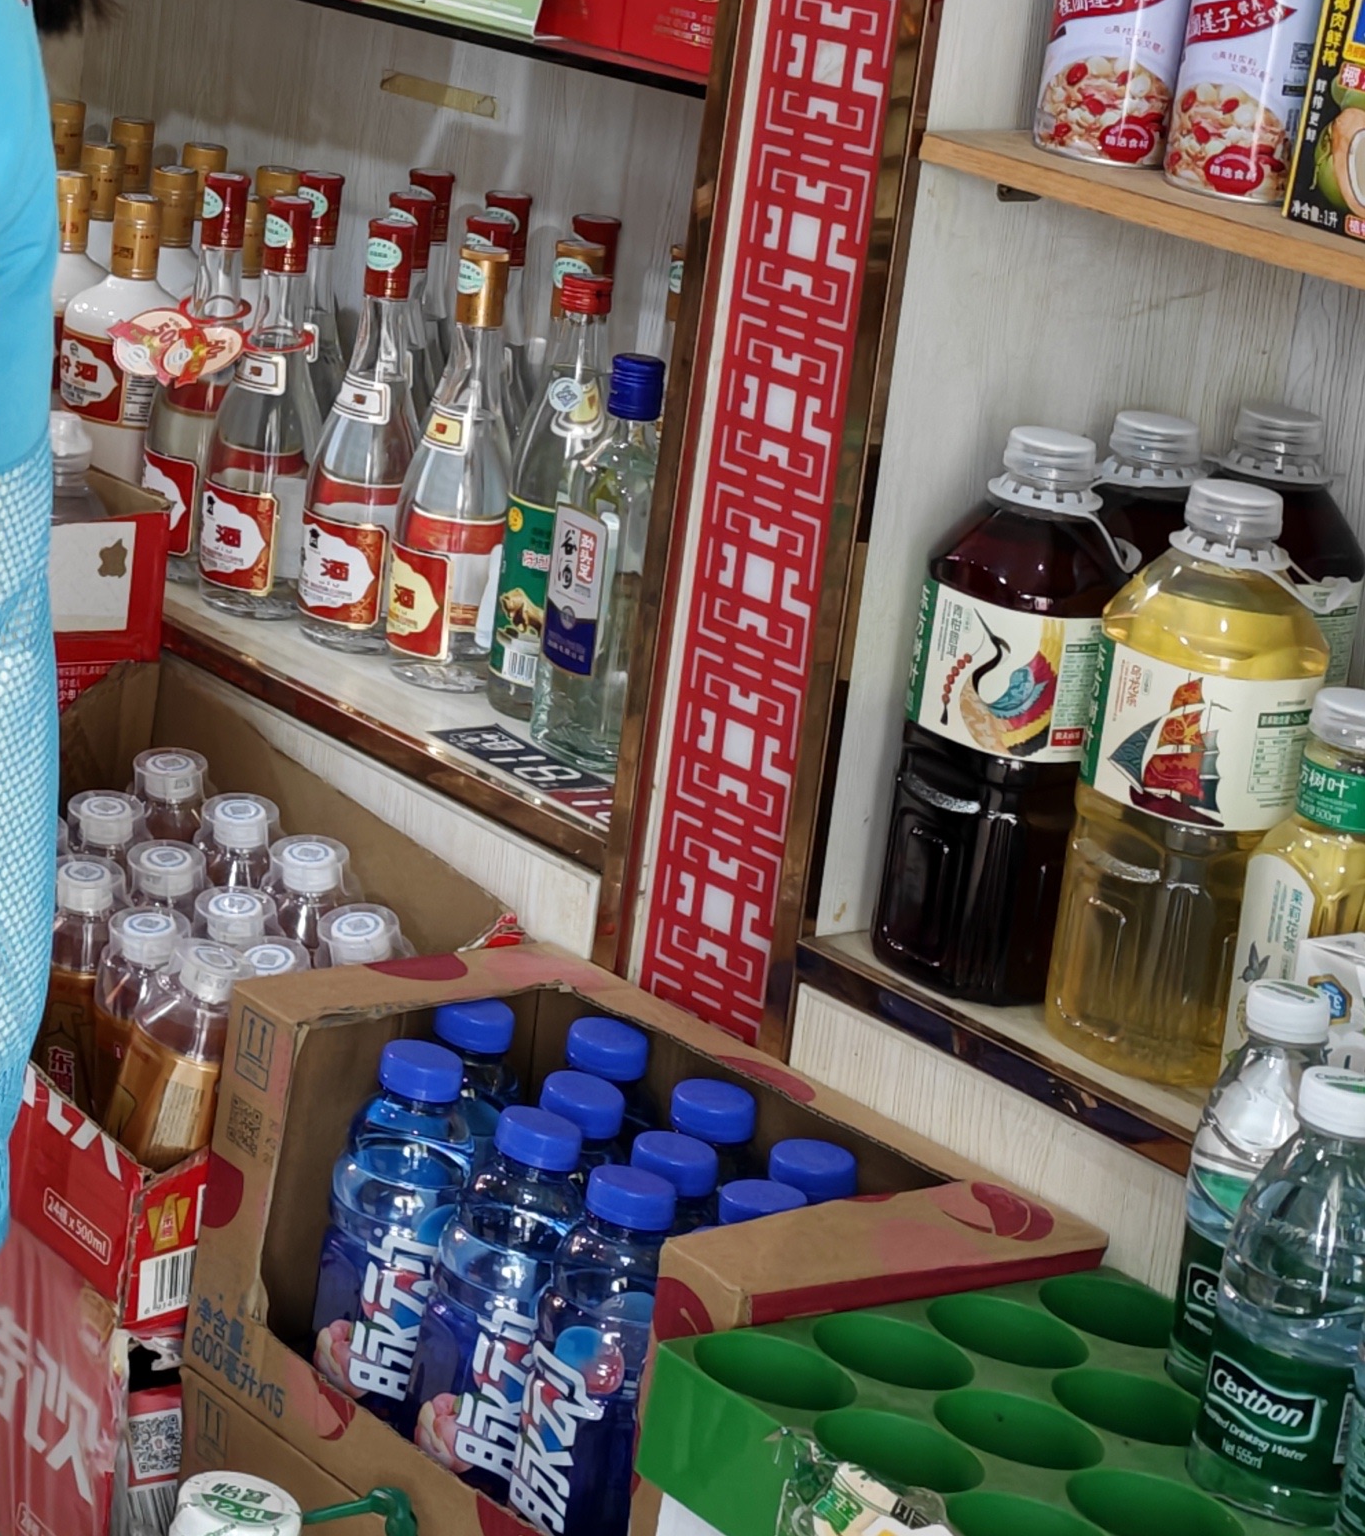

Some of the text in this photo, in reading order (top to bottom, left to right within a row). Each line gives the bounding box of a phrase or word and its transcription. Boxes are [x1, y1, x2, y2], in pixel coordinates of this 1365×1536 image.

[1105, 134, 1149, 151] 精选食材
[1208, 164, 1258, 183] 精选食材
[1300, 763, 1350, 799] 方树叶
[1213, 1368, 1305, 1428] C'estbon
[1221, 1437, 1264, 1470] Net 555ml
[1271, 1443, 1308, 1462] Water
